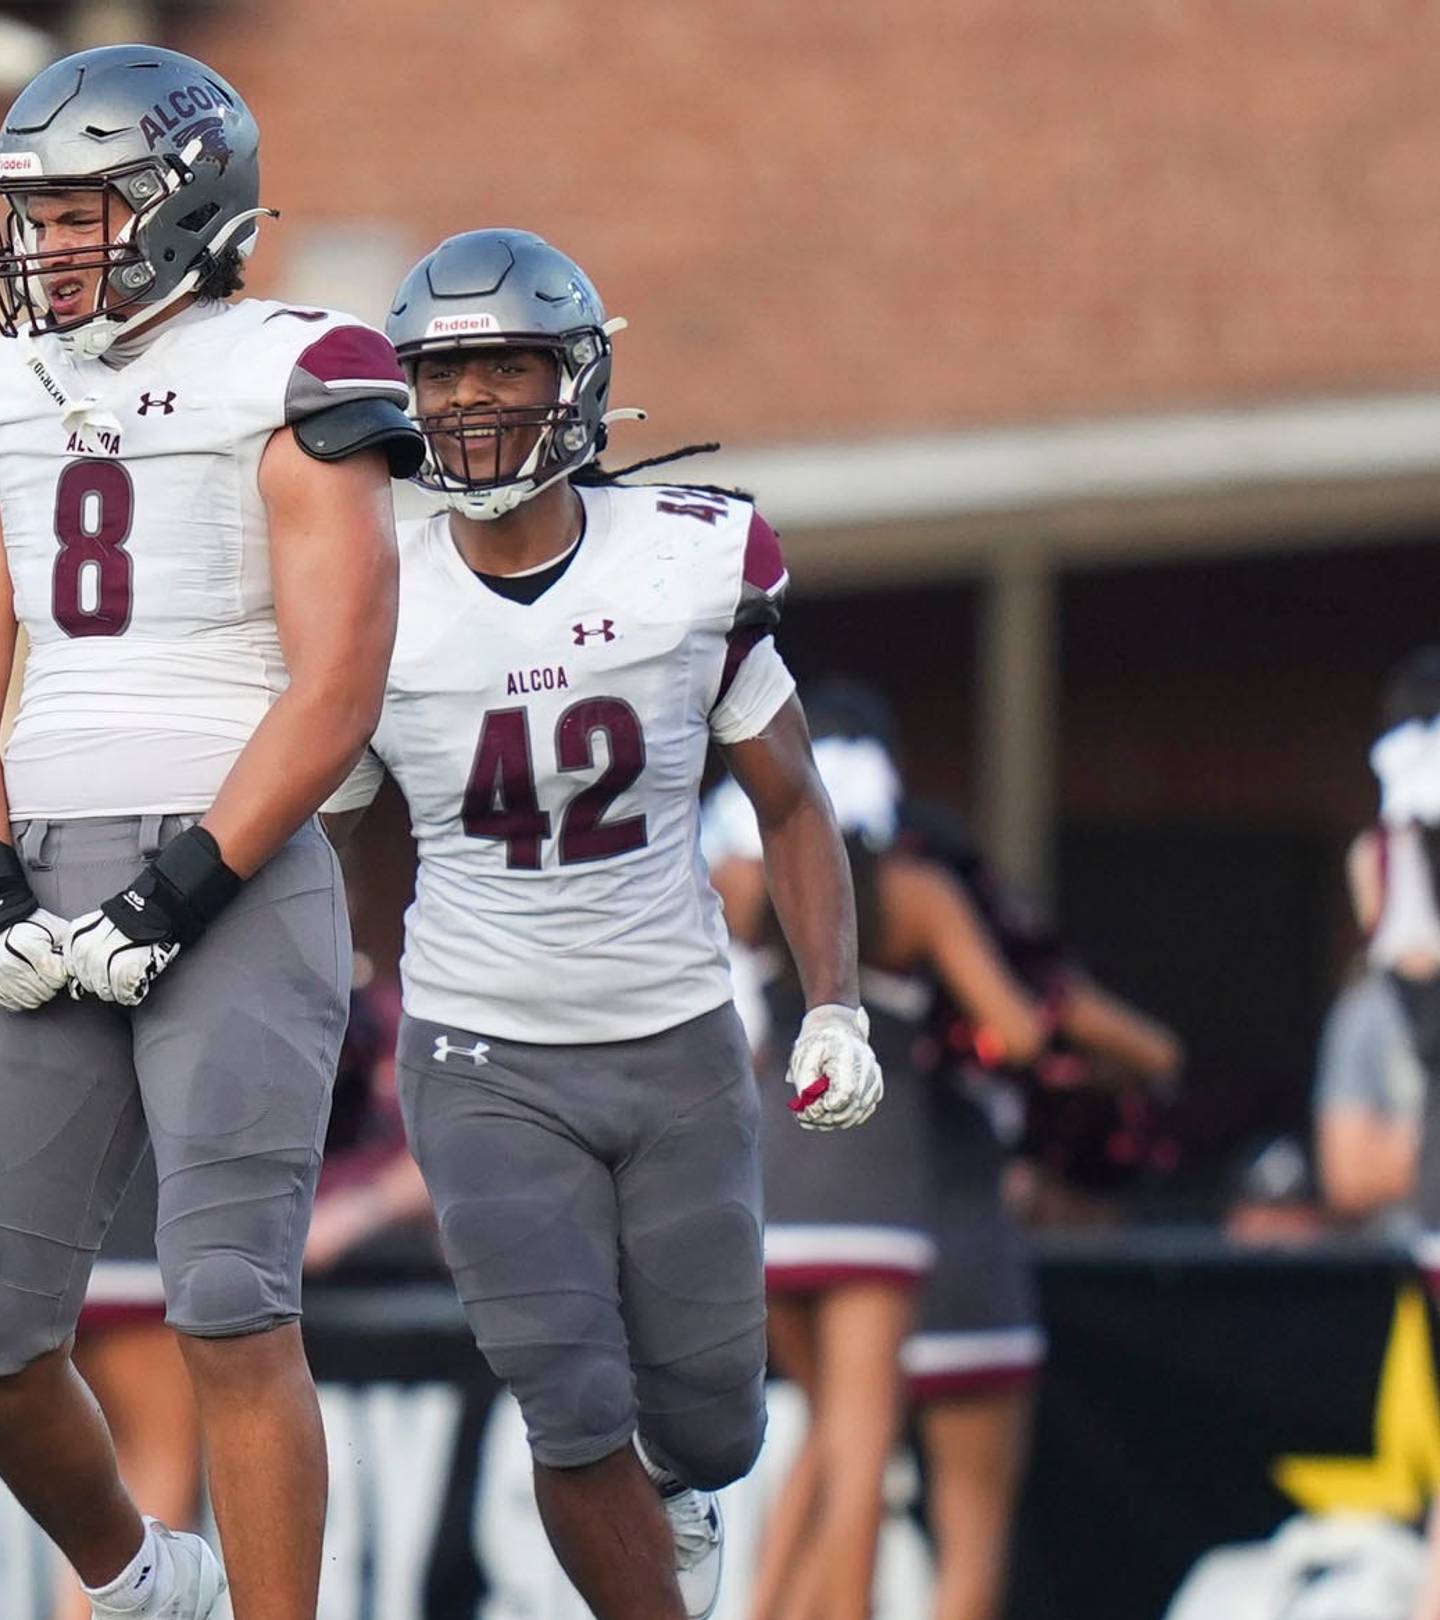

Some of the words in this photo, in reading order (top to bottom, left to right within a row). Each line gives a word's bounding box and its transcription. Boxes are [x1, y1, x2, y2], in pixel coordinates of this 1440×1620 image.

[140, 85, 231, 152] ALCOA
[433, 317, 490, 333] Riddell
[51, 458, 135, 639] 8
[507, 666, 568, 696] ALCOA
[461, 695, 649, 871] 42
